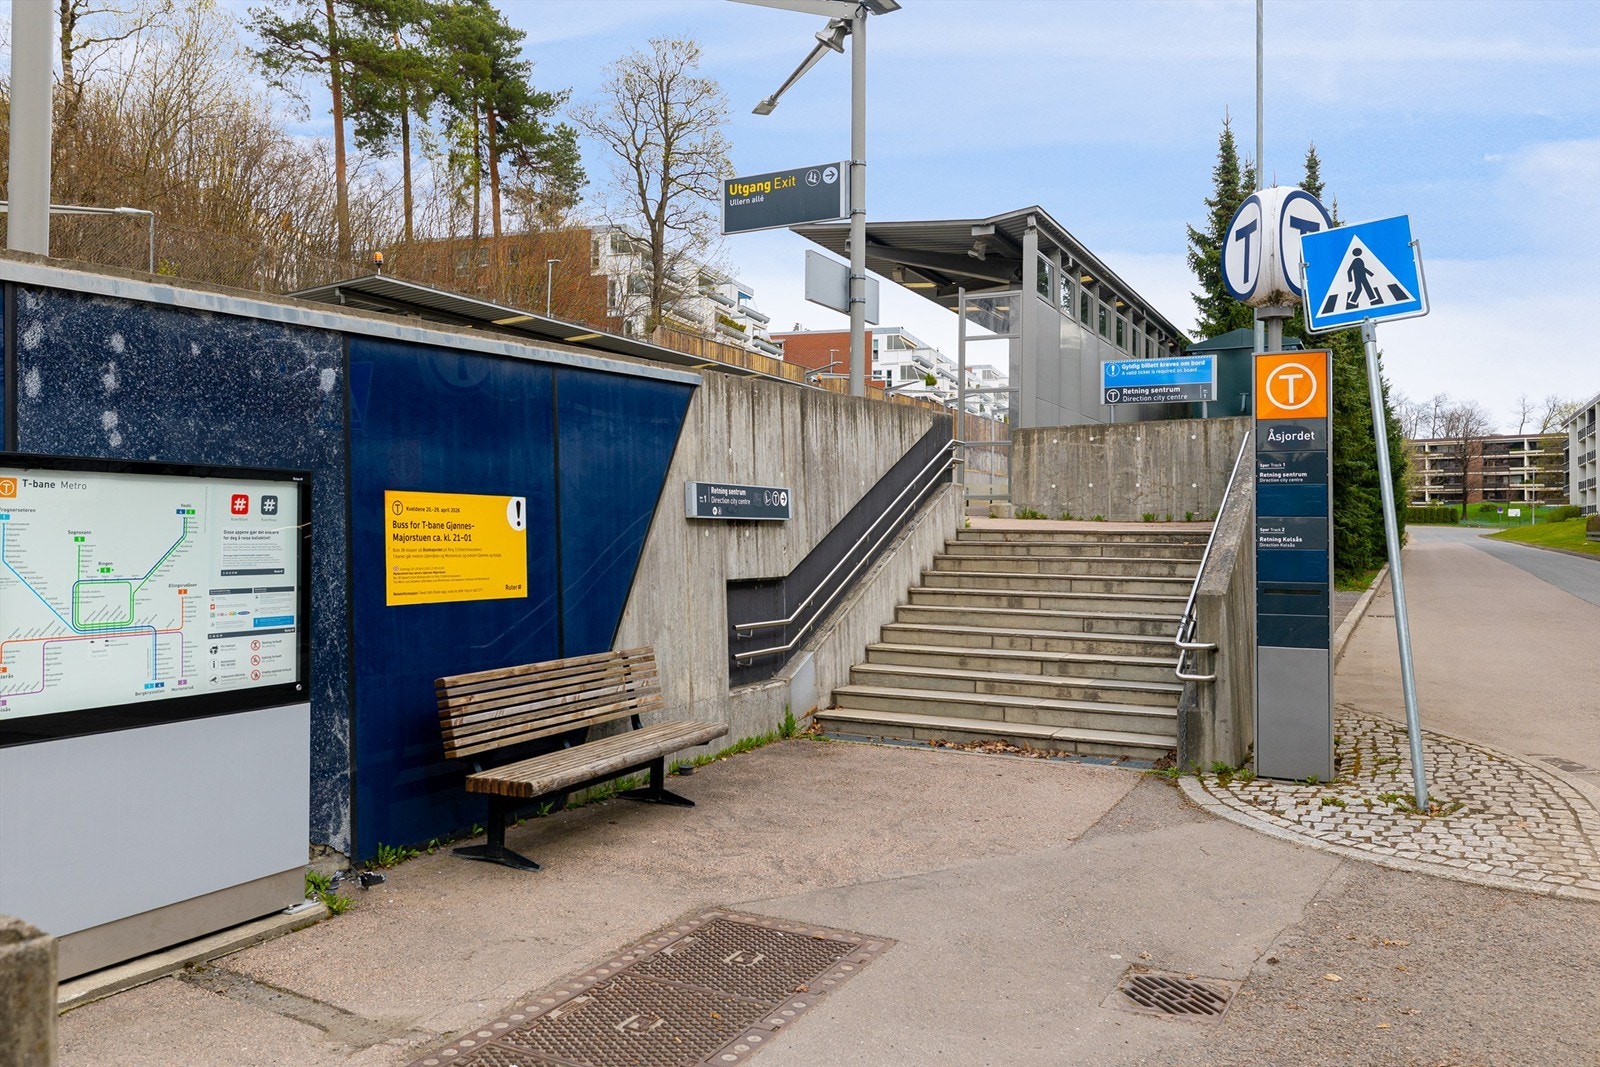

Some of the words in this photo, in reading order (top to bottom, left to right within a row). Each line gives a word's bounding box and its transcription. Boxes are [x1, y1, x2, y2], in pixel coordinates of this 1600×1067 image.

[729, 181, 771, 197] Utgang
[774, 175, 796, 189] Exit
[729, 199, 751, 207] Ullern
[751, 194, 764, 204] allé
[1235, 217, 1258, 285] T
[1121, 363, 1140, 371] Gyldig
[1122, 387, 1150, 396] Retning
[1278, 373, 1304, 404] T
[1267, 428, 1315, 443] Åsjordet
[22, 478, 56, 489] T-bane
[60, 481, 87, 490] Metro
[711, 486, 728, 496] Retning
[728, 488, 747, 496] sentrum
[710, 496, 730, 504] Direction
[730, 498, 738, 506] city
[392, 520, 409, 529] Buss
[410, 521, 420, 529] for
[421, 521, 445, 529] T-bane
[446, 521, 475, 531] Gjønnes-
[392, 533, 431, 543] Majorstuen
[443, 533, 451, 542] kl.
